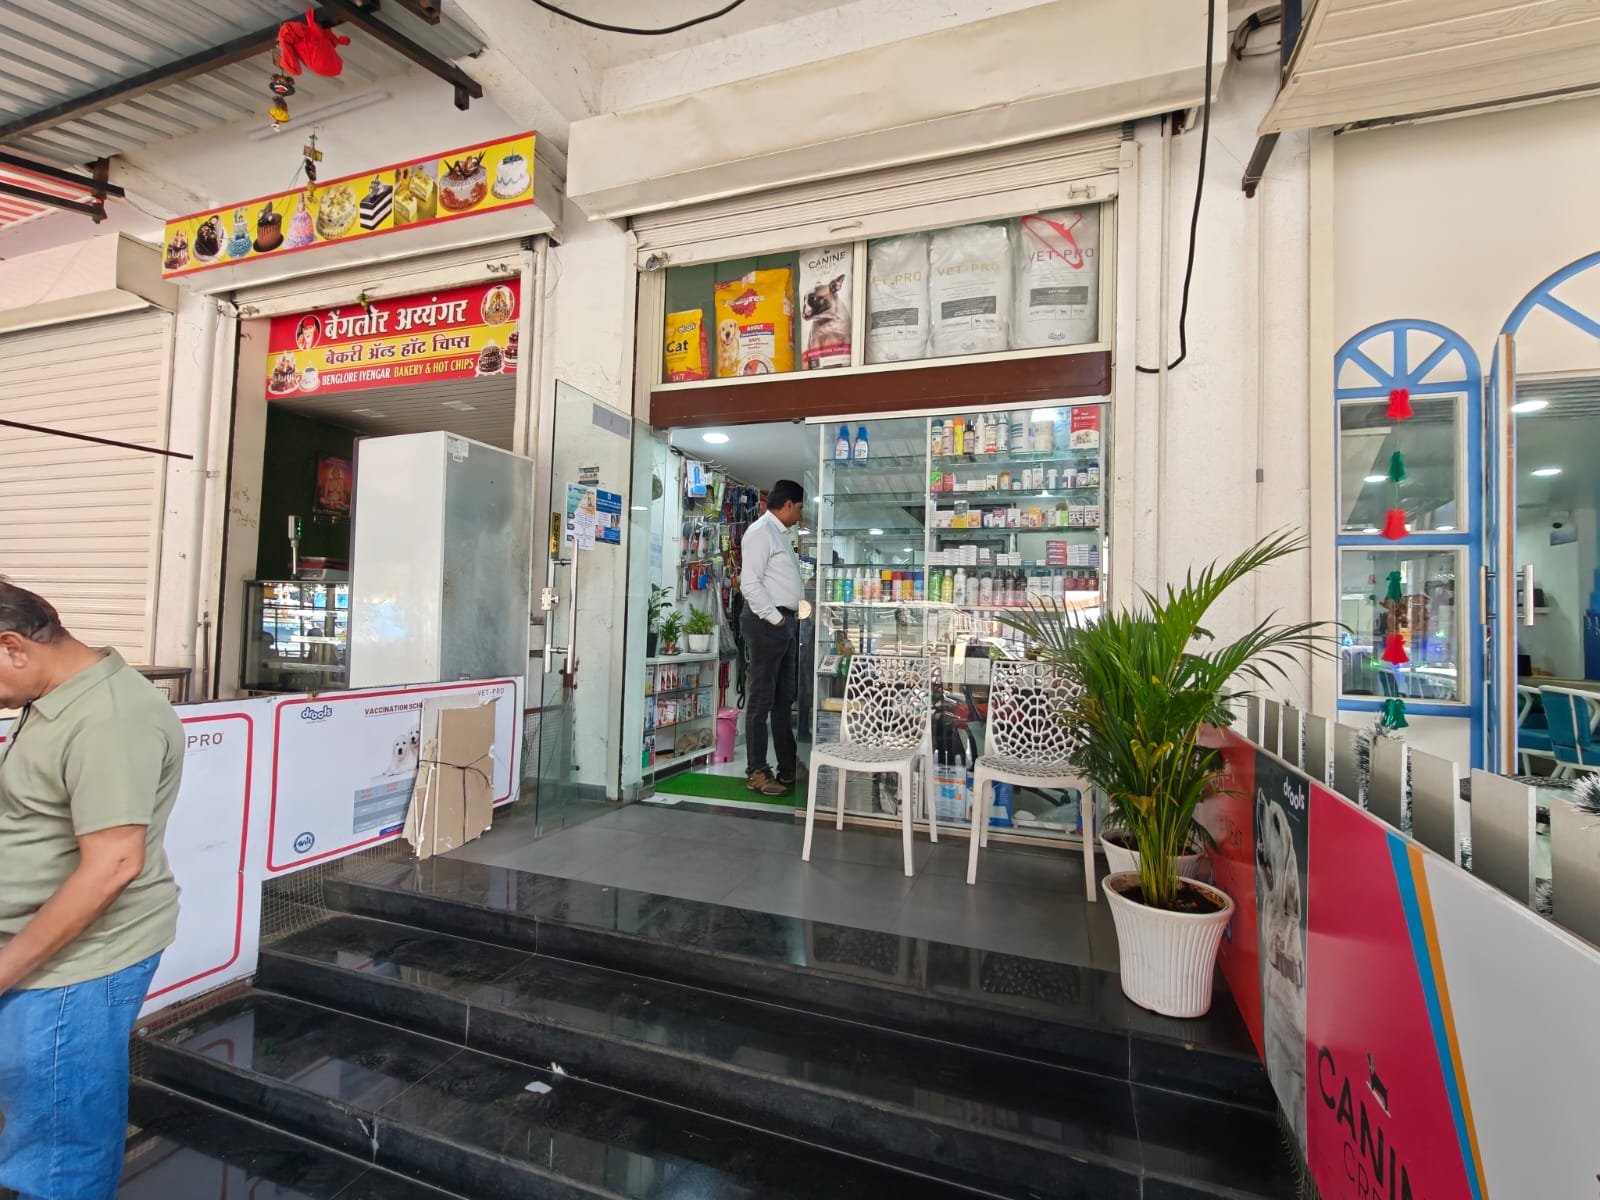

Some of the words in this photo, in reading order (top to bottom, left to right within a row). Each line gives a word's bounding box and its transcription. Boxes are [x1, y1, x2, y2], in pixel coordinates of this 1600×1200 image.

[808, 251, 846, 269] CANINE
[325, 344, 363, 364] बेकरी
[401, 338, 427, 357] हॉट
[432, 333, 471, 352] चिप्स
[666, 340, 689, 354] Cat
[322, 371, 358, 386] BENGLORE
[359, 368, 390, 382] IYENGAR
[394, 364, 424, 377] BAKERY
[425, 363, 431, 374] &
[433, 361, 449, 373] HOT
[450, 358, 474, 371] CHIPS
[552, 514, 560, 550] PUSH
[477, 688, 505, 697] VET-PRO
[301, 704, 333, 720] drools
[365, 703, 408, 715] VACCINATION
[1283, 775, 1305, 810] drools
